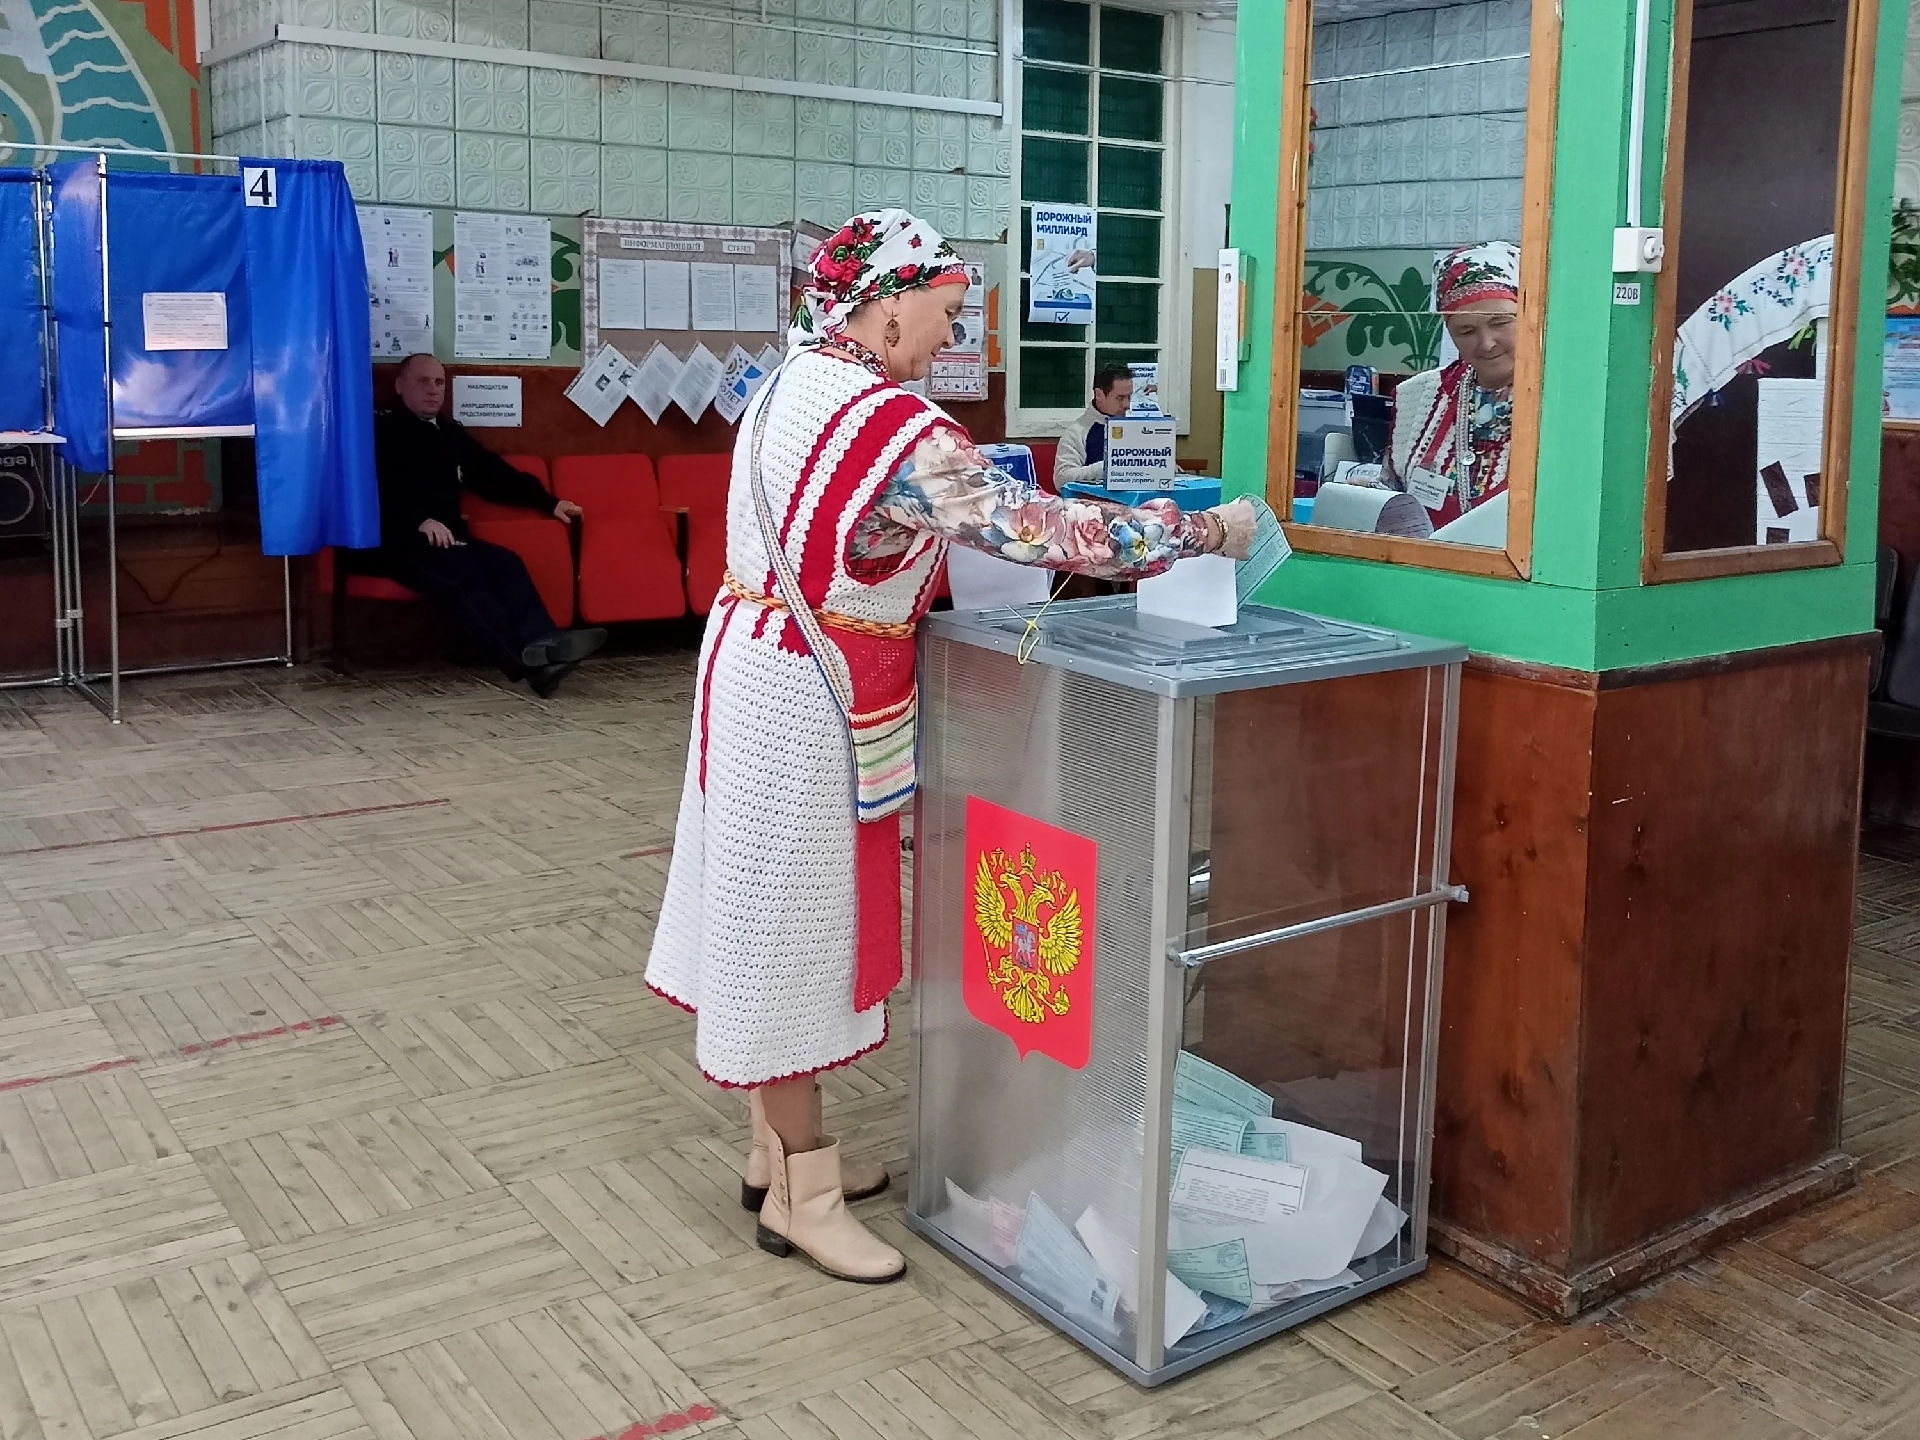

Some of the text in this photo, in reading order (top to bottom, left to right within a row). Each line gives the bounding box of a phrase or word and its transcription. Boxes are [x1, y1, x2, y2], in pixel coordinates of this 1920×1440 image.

[250, 169, 272, 205] 4
[1036, 211, 1092, 224] ДОРОЖНЫЙ
[1036, 224, 1088, 237] МИЛЛИАРД
[624, 239, 701, 251] ИНФОРМАЦИОННЫЙ
[1111, 447, 1172, 458] ДОРОЖНЫЙ
[1111, 458, 1167, 469] МИЛЛИАРД
